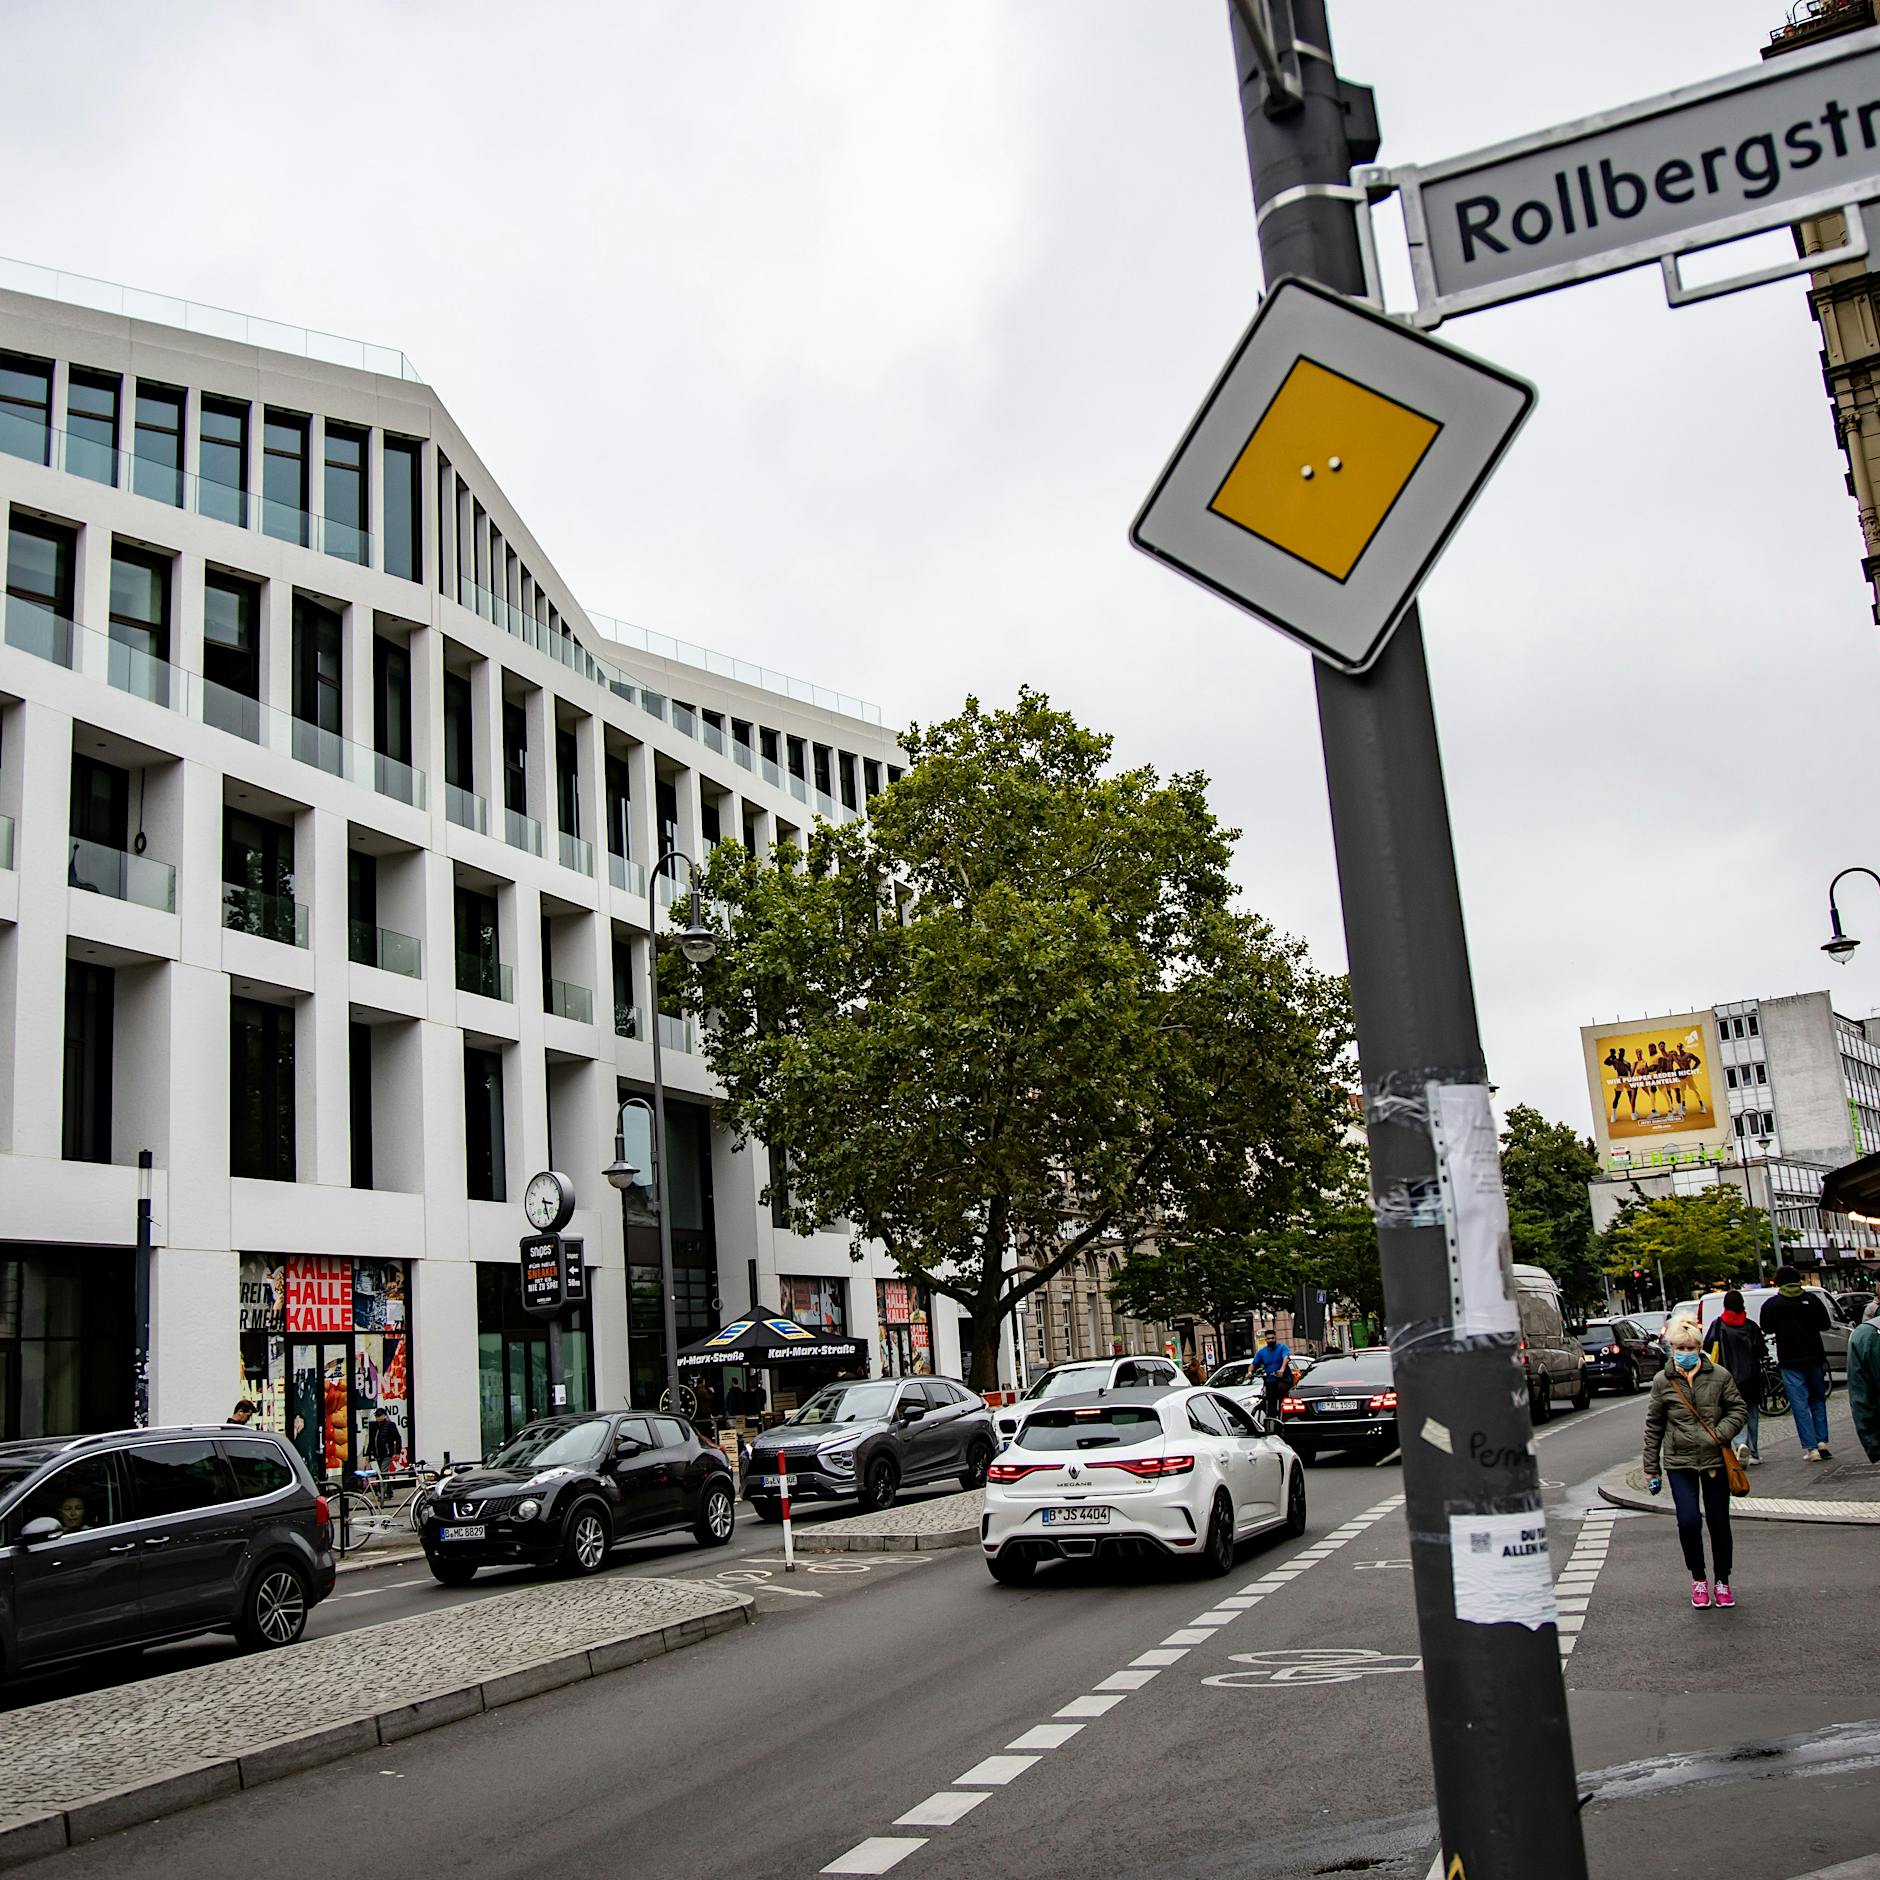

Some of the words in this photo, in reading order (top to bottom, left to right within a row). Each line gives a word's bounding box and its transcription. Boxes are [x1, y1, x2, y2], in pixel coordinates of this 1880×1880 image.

[1653, 1071, 1677, 1079] REDEN
[286, 1256, 353, 1281] KALLE
[286, 1281, 353, 1306] HALLE
[286, 1307, 353, 1331] KALLE
[676, 1351, 745, 1366] rl-Marx-Straße
[768, 1344, 856, 1359] Karl-Marx-Straße
[1340, 1401, 1357, 1409] 1559
[1049, 1509, 1057, 1521] B
[1063, 1508, 1078, 1520] JS
[1080, 1508, 1107, 1520] 4404
[445, 1529, 450, 1538] B
[465, 1526, 484, 1537] 8829
[1521, 1528, 1536, 1542] DU
[1503, 1543, 1537, 1557] ALLEN
